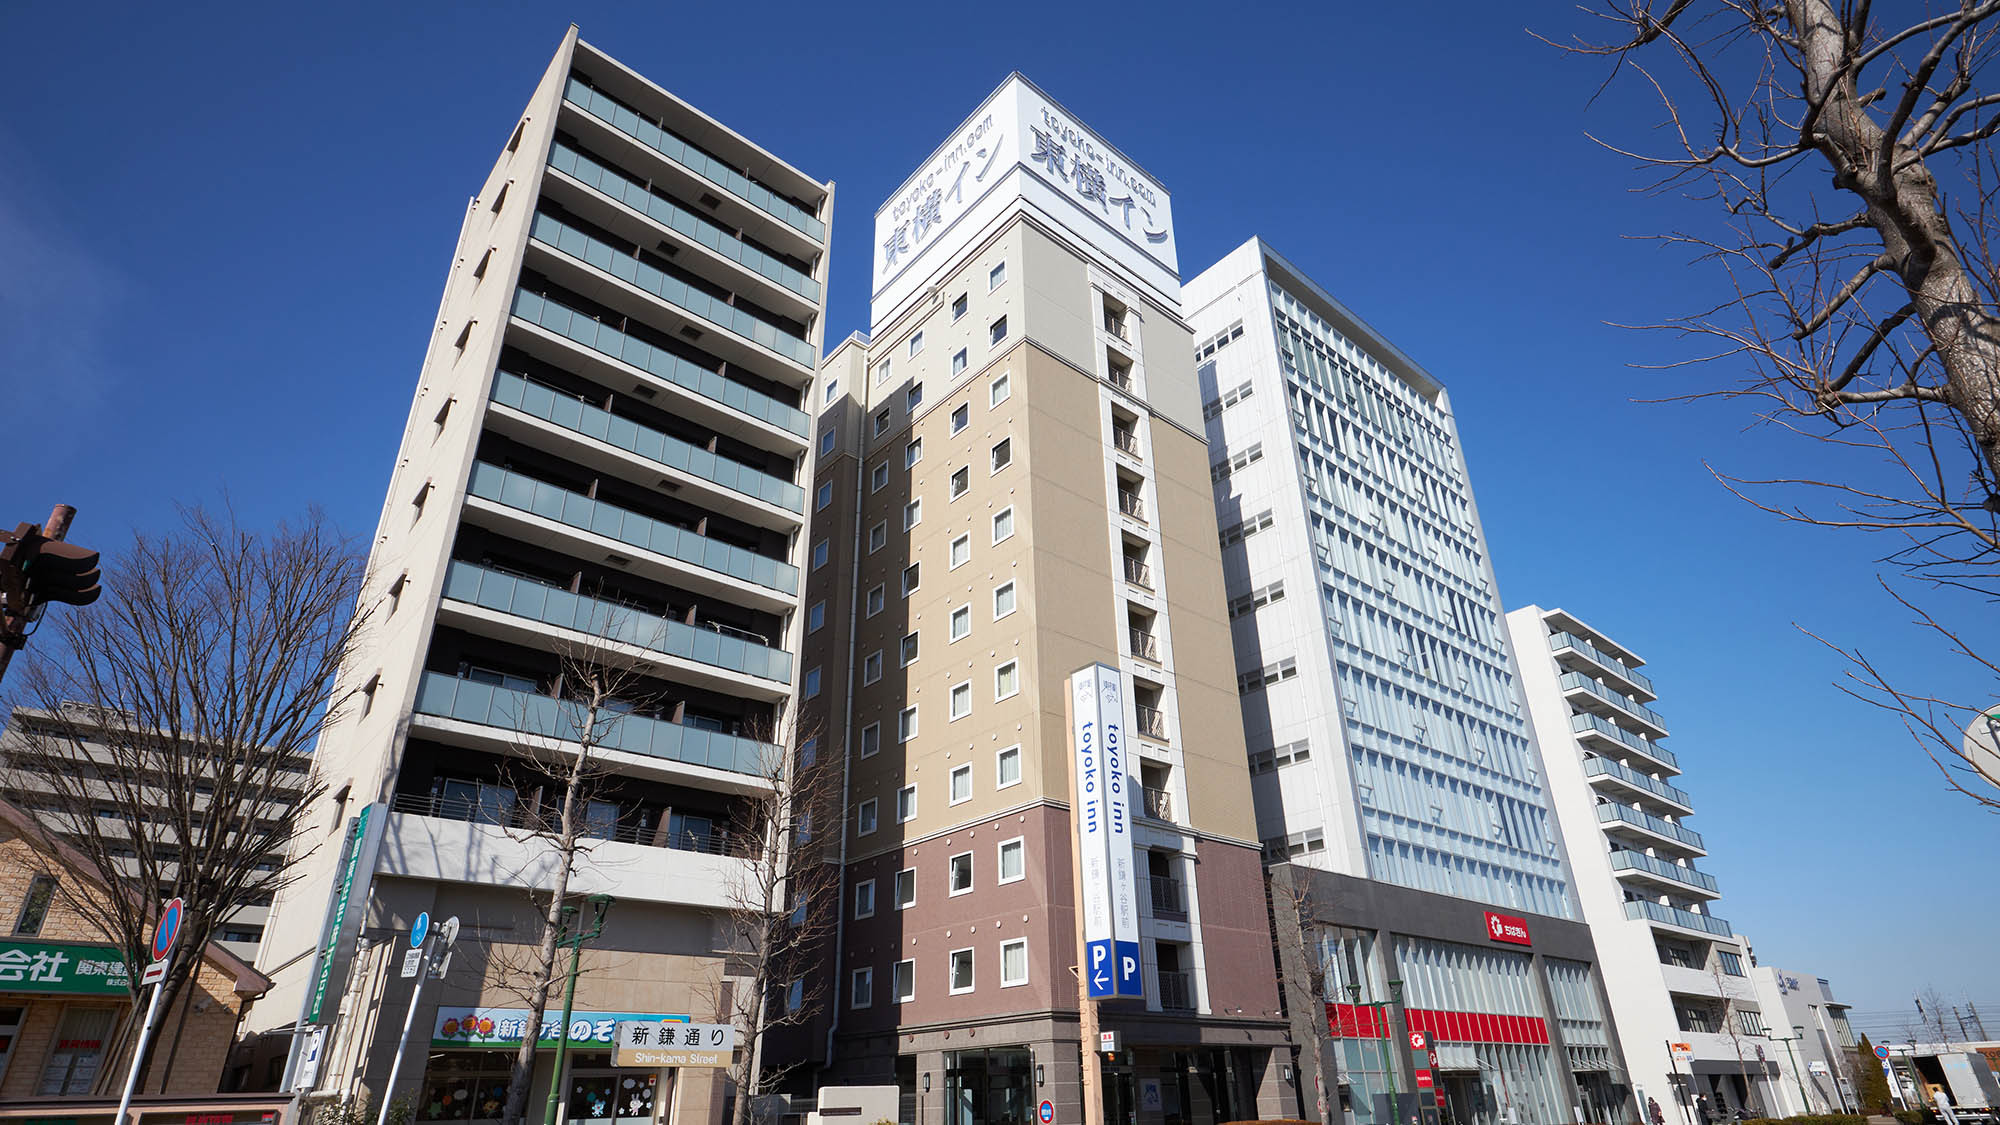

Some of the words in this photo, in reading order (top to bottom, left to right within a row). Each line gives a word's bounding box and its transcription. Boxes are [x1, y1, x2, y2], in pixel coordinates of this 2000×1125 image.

[893, 114, 993, 222] toyoko-inn.com
[1040, 107, 1156, 208] toyoko-inn.com
[1030, 125, 1168, 243] 東横イン
[882, 134, 1003, 275] 東横イン
[1081, 721, 1097, 793] toyoko
[1107, 723, 1123, 794] toyoko
[1086, 799, 1099, 833] inn
[1113, 801, 1125, 834] inn
[0, 949, 69, 982] 会社
[1092, 944, 1107, 970] P
[1122, 956, 1136, 981] P
[631, 1026, 725, 1046] 新鎌通り
[634, 1052, 687, 1064] Shin-kama
[689, 1053, 718, 1065] Street
